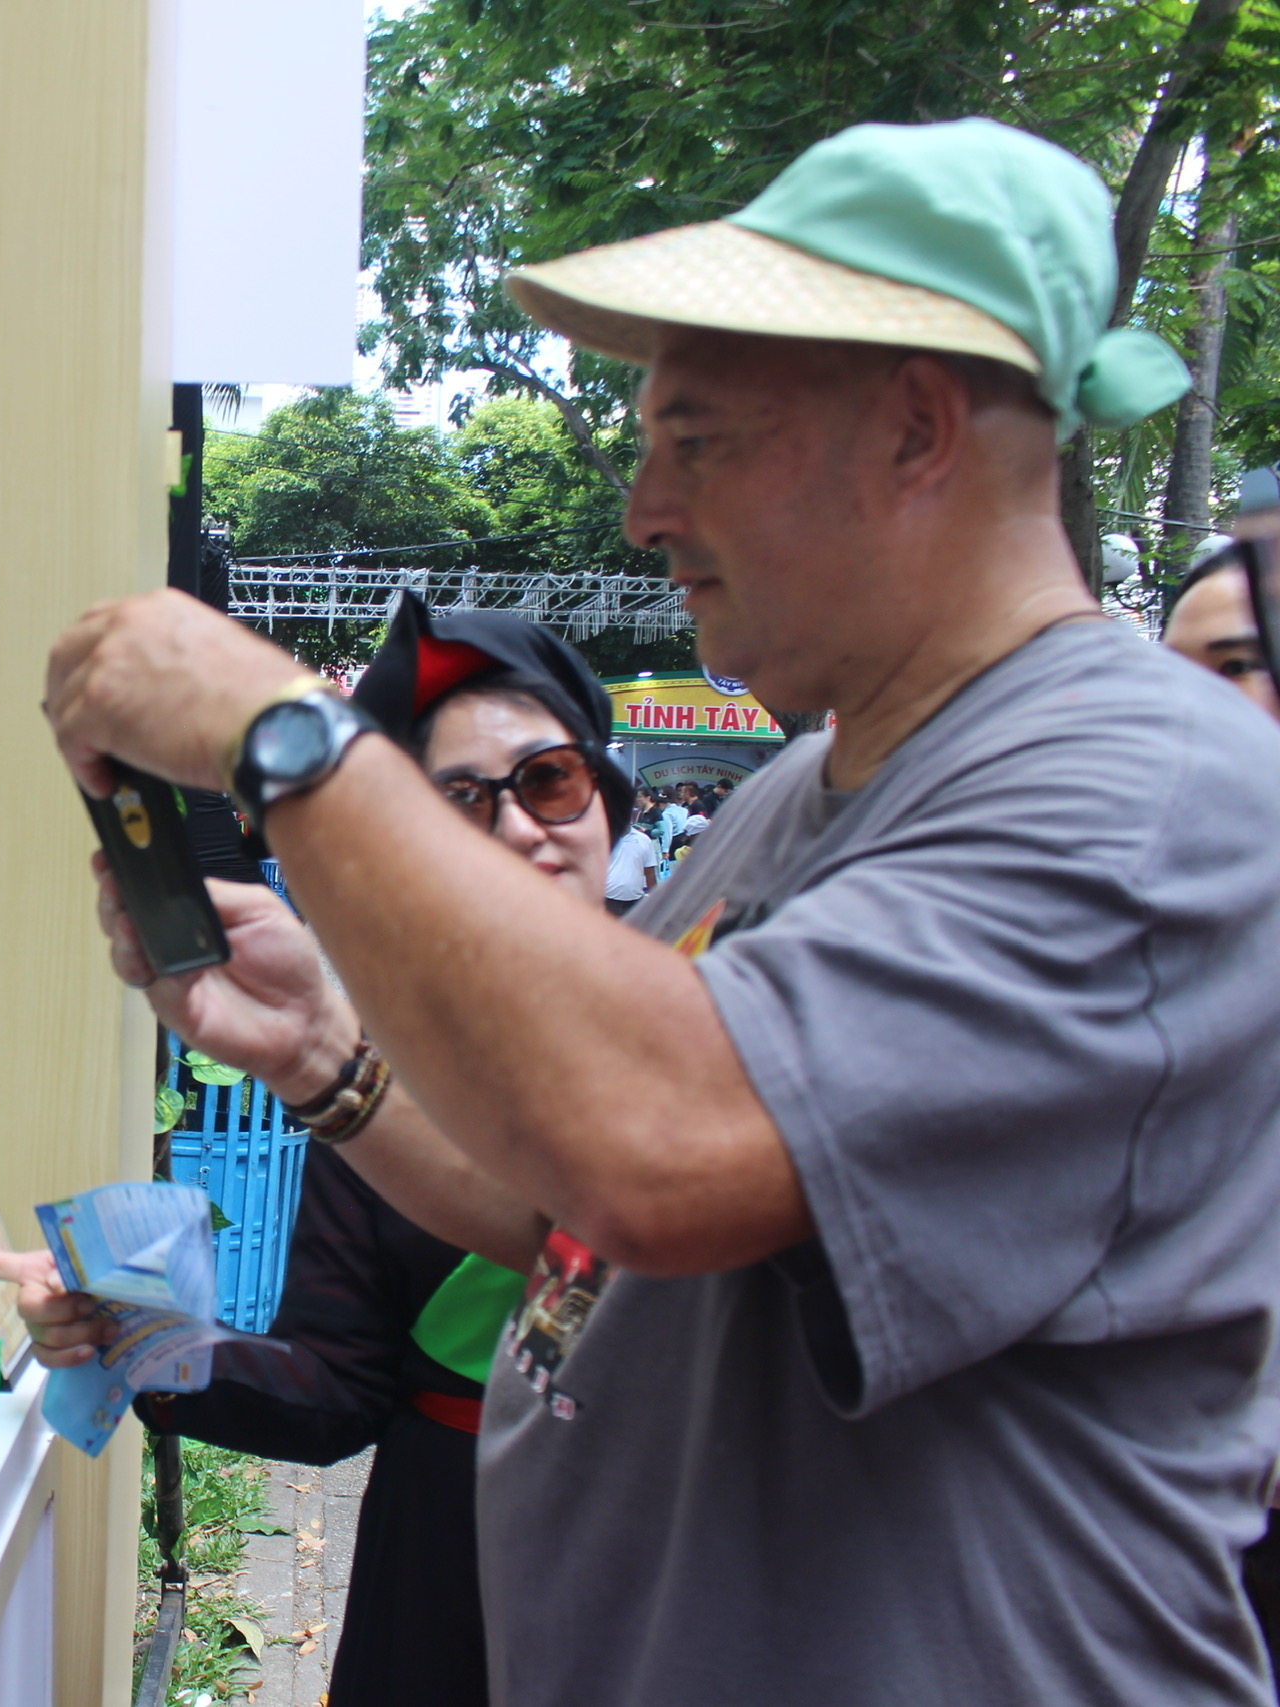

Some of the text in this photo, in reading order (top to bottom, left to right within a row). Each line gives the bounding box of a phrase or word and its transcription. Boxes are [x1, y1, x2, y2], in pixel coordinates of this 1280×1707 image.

[626, 697, 695, 730] TỈNH
[704, 702, 761, 732] TÂY
[654, 769, 669, 779] DU
[717, 768, 743, 782] NINH
